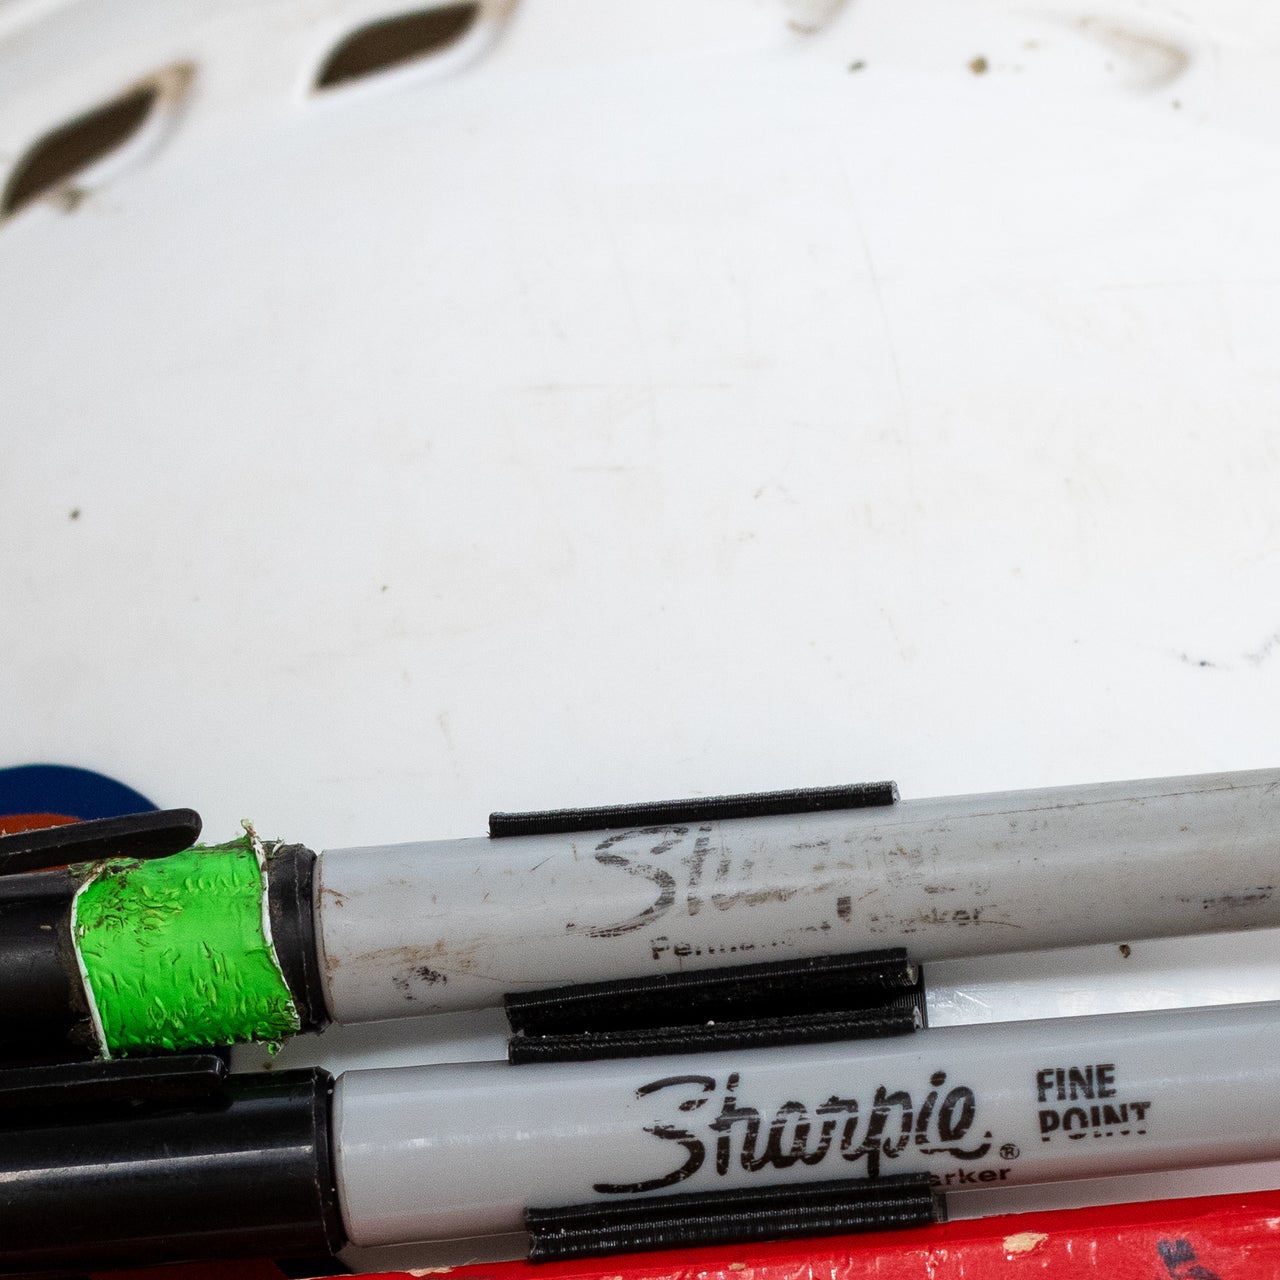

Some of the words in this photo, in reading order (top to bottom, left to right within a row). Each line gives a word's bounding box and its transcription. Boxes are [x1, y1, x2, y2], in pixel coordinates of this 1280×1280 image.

[1036, 1063, 1117, 1102] FINE
[1038, 1101, 1152, 1142] POINT
[926, 1167, 1012, 1187] arker
